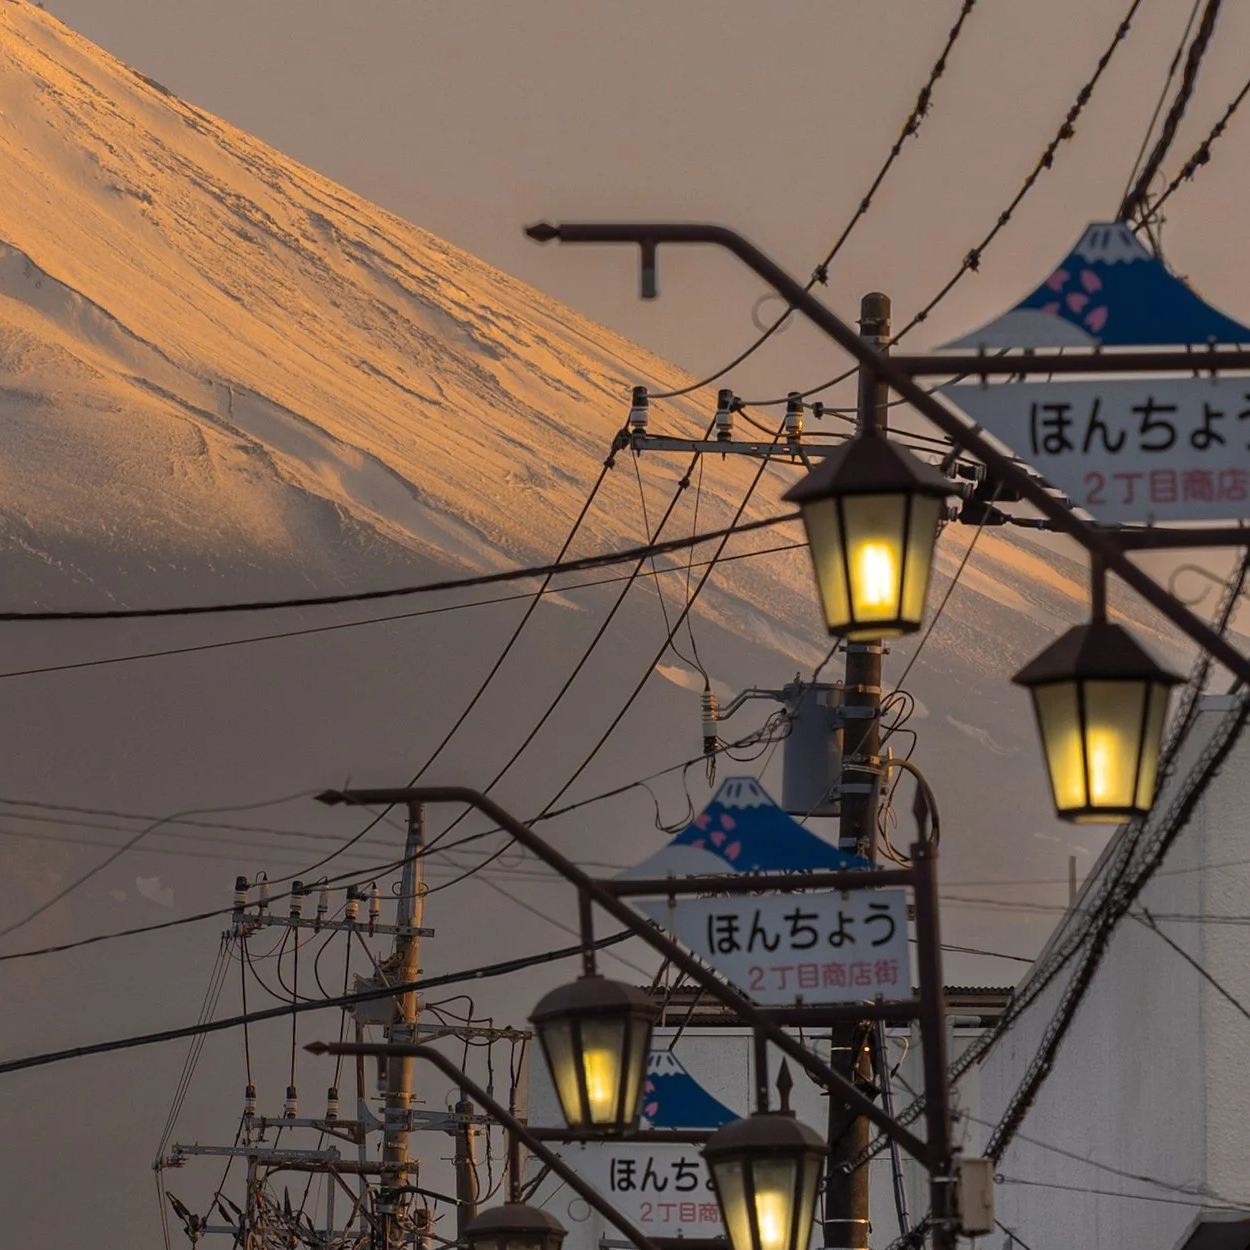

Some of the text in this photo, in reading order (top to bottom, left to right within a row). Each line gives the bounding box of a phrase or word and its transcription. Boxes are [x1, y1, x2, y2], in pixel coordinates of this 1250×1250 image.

[707, 902, 896, 955] ほんちょう
[748, 959, 898, 992] 2丁目商店街
